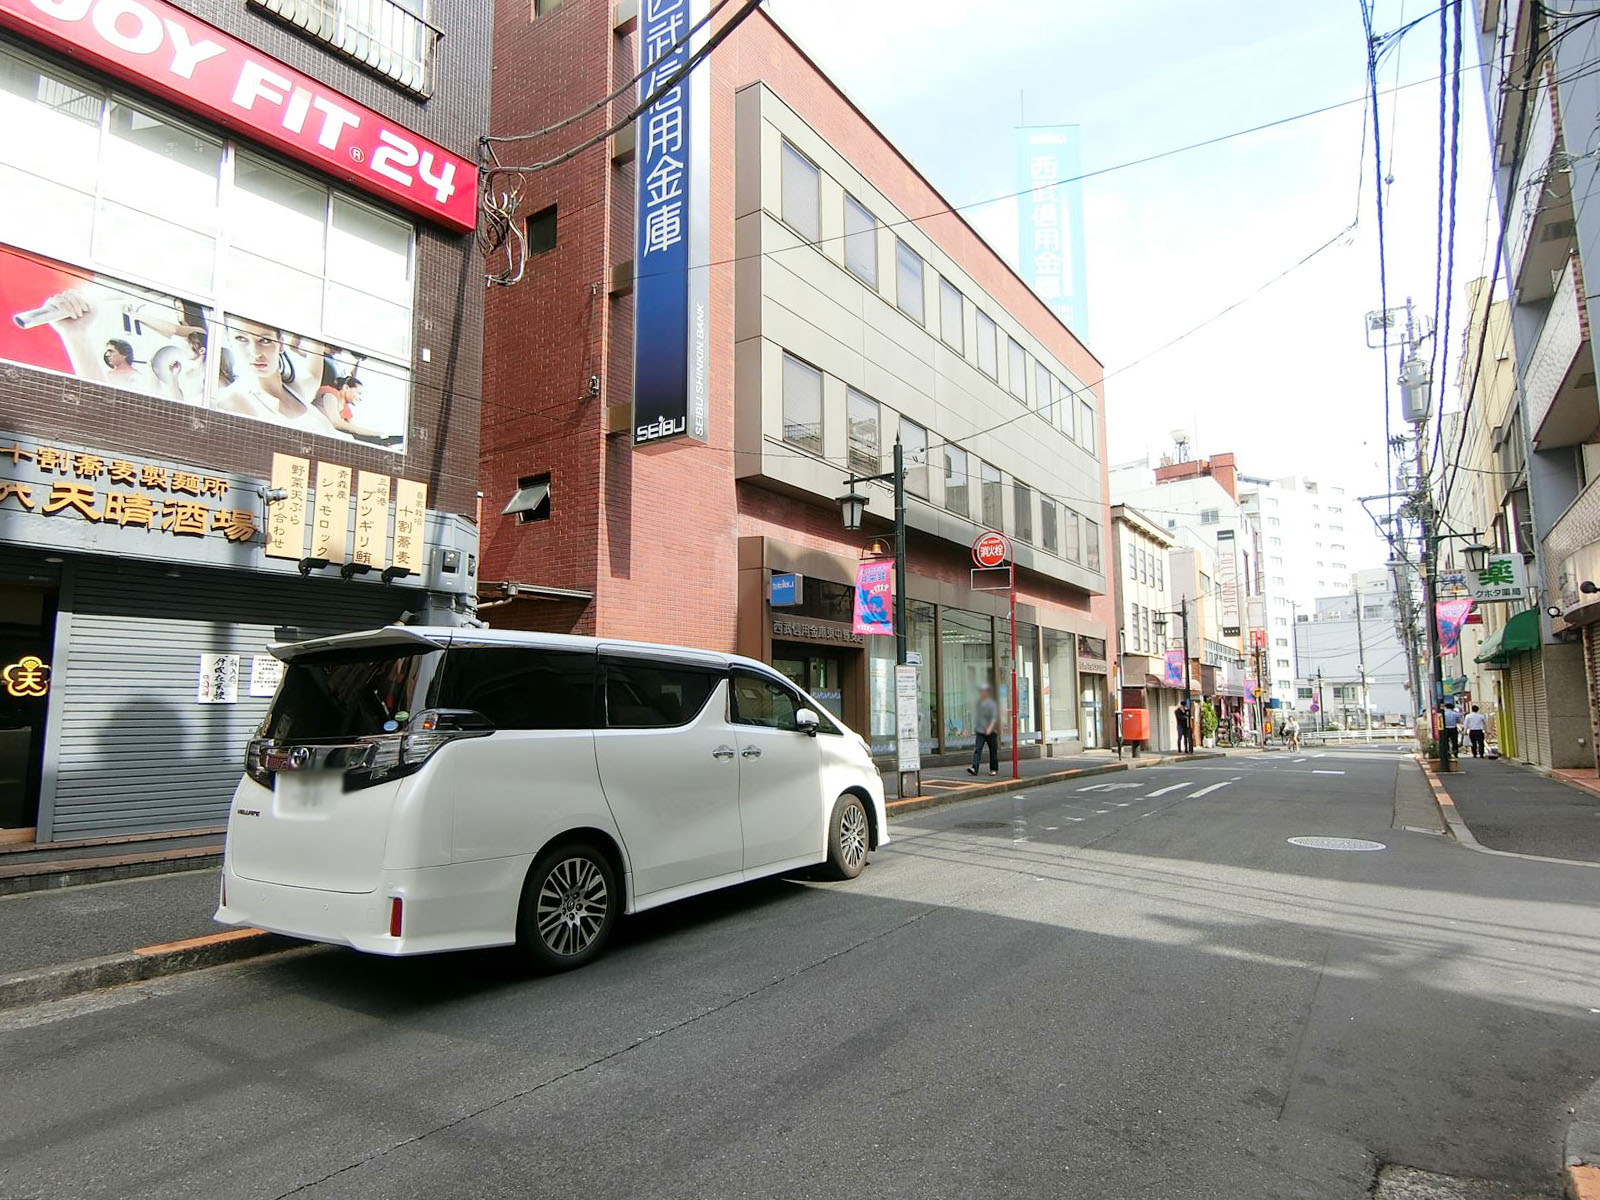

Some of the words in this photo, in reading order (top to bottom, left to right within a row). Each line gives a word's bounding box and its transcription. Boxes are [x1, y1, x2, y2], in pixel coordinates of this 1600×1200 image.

[232, 59, 361, 151] FIT
[370, 129, 456, 204] 24
[695, 303, 704, 339] BANK
[695, 341, 704, 395] SHINKIN
[636, 416, 686, 442] SEIBU
[695, 398, 704, 436] SEIBU
[271, 499, 287, 549] り合わせ
[316, 477, 334, 557] シャモロック
[1478, 559, 1514, 586] 薬
[18, 671, 42, 691] 天
